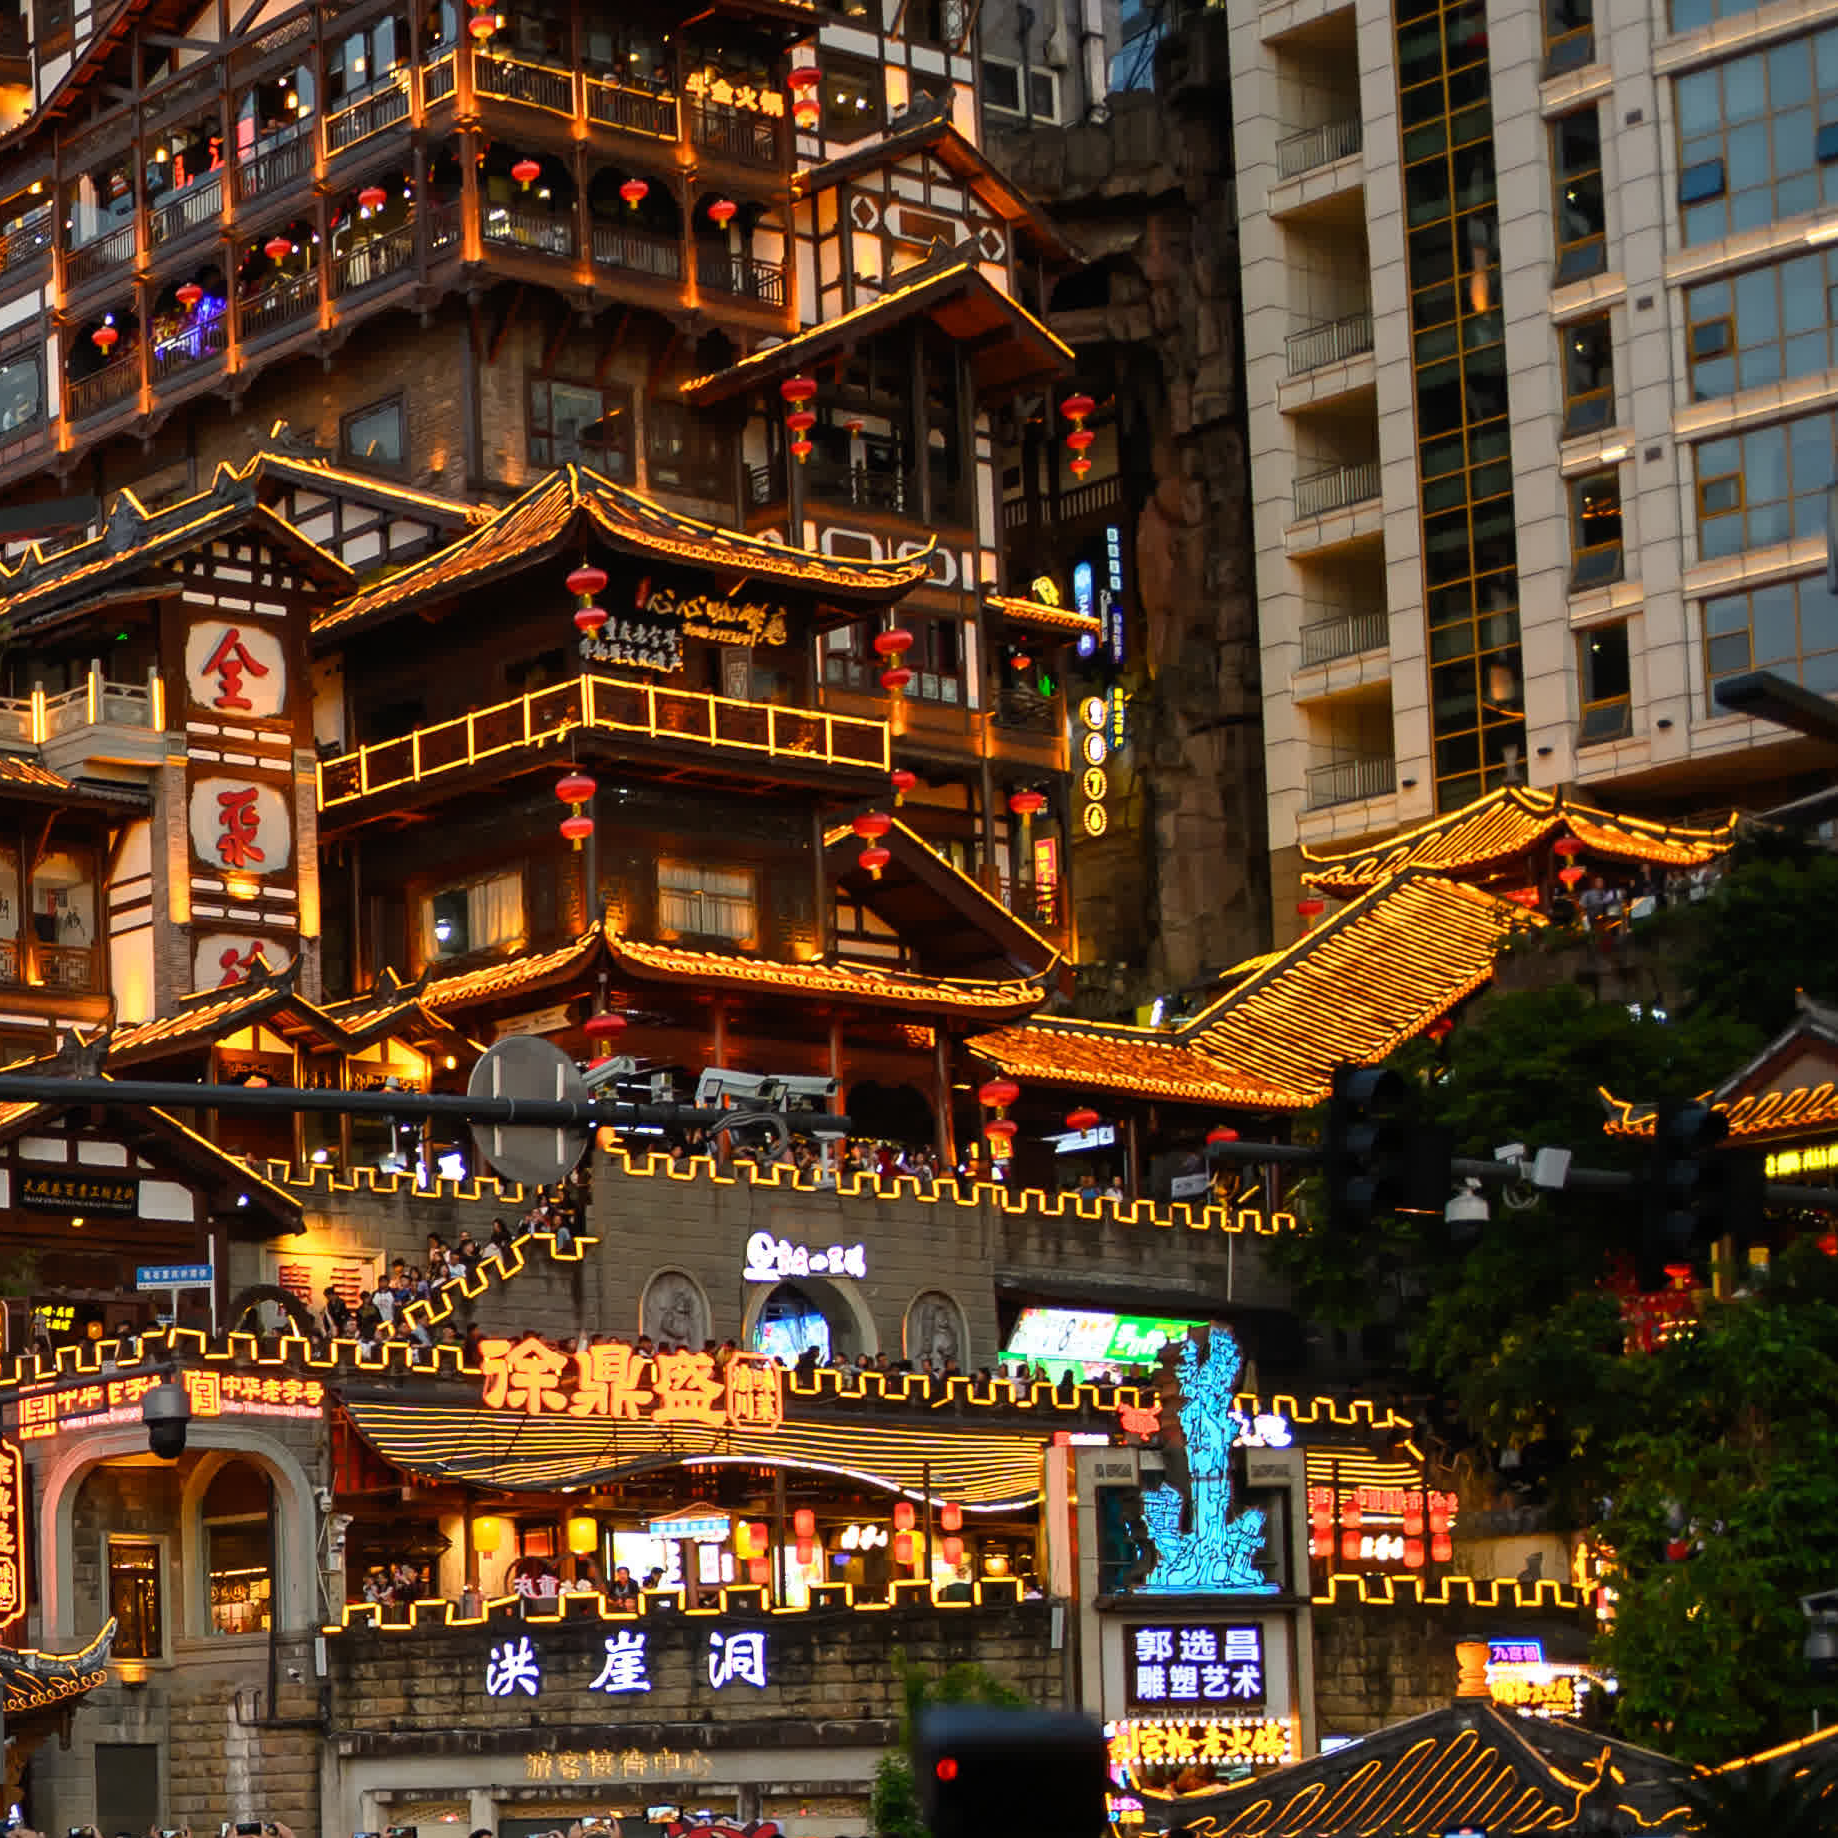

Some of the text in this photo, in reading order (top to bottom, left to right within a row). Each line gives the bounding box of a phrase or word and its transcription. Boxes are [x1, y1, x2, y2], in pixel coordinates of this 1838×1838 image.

[221, 1375, 325, 1406] 中华老字号
[479, 1336, 725, 1427] 徐鼎盛
[1135, 1630, 1260, 1662] 郭选昌
[486, 1630, 767, 1696] 洪崖洞
[1136, 1665, 1261, 1698] 雕塑艺术
